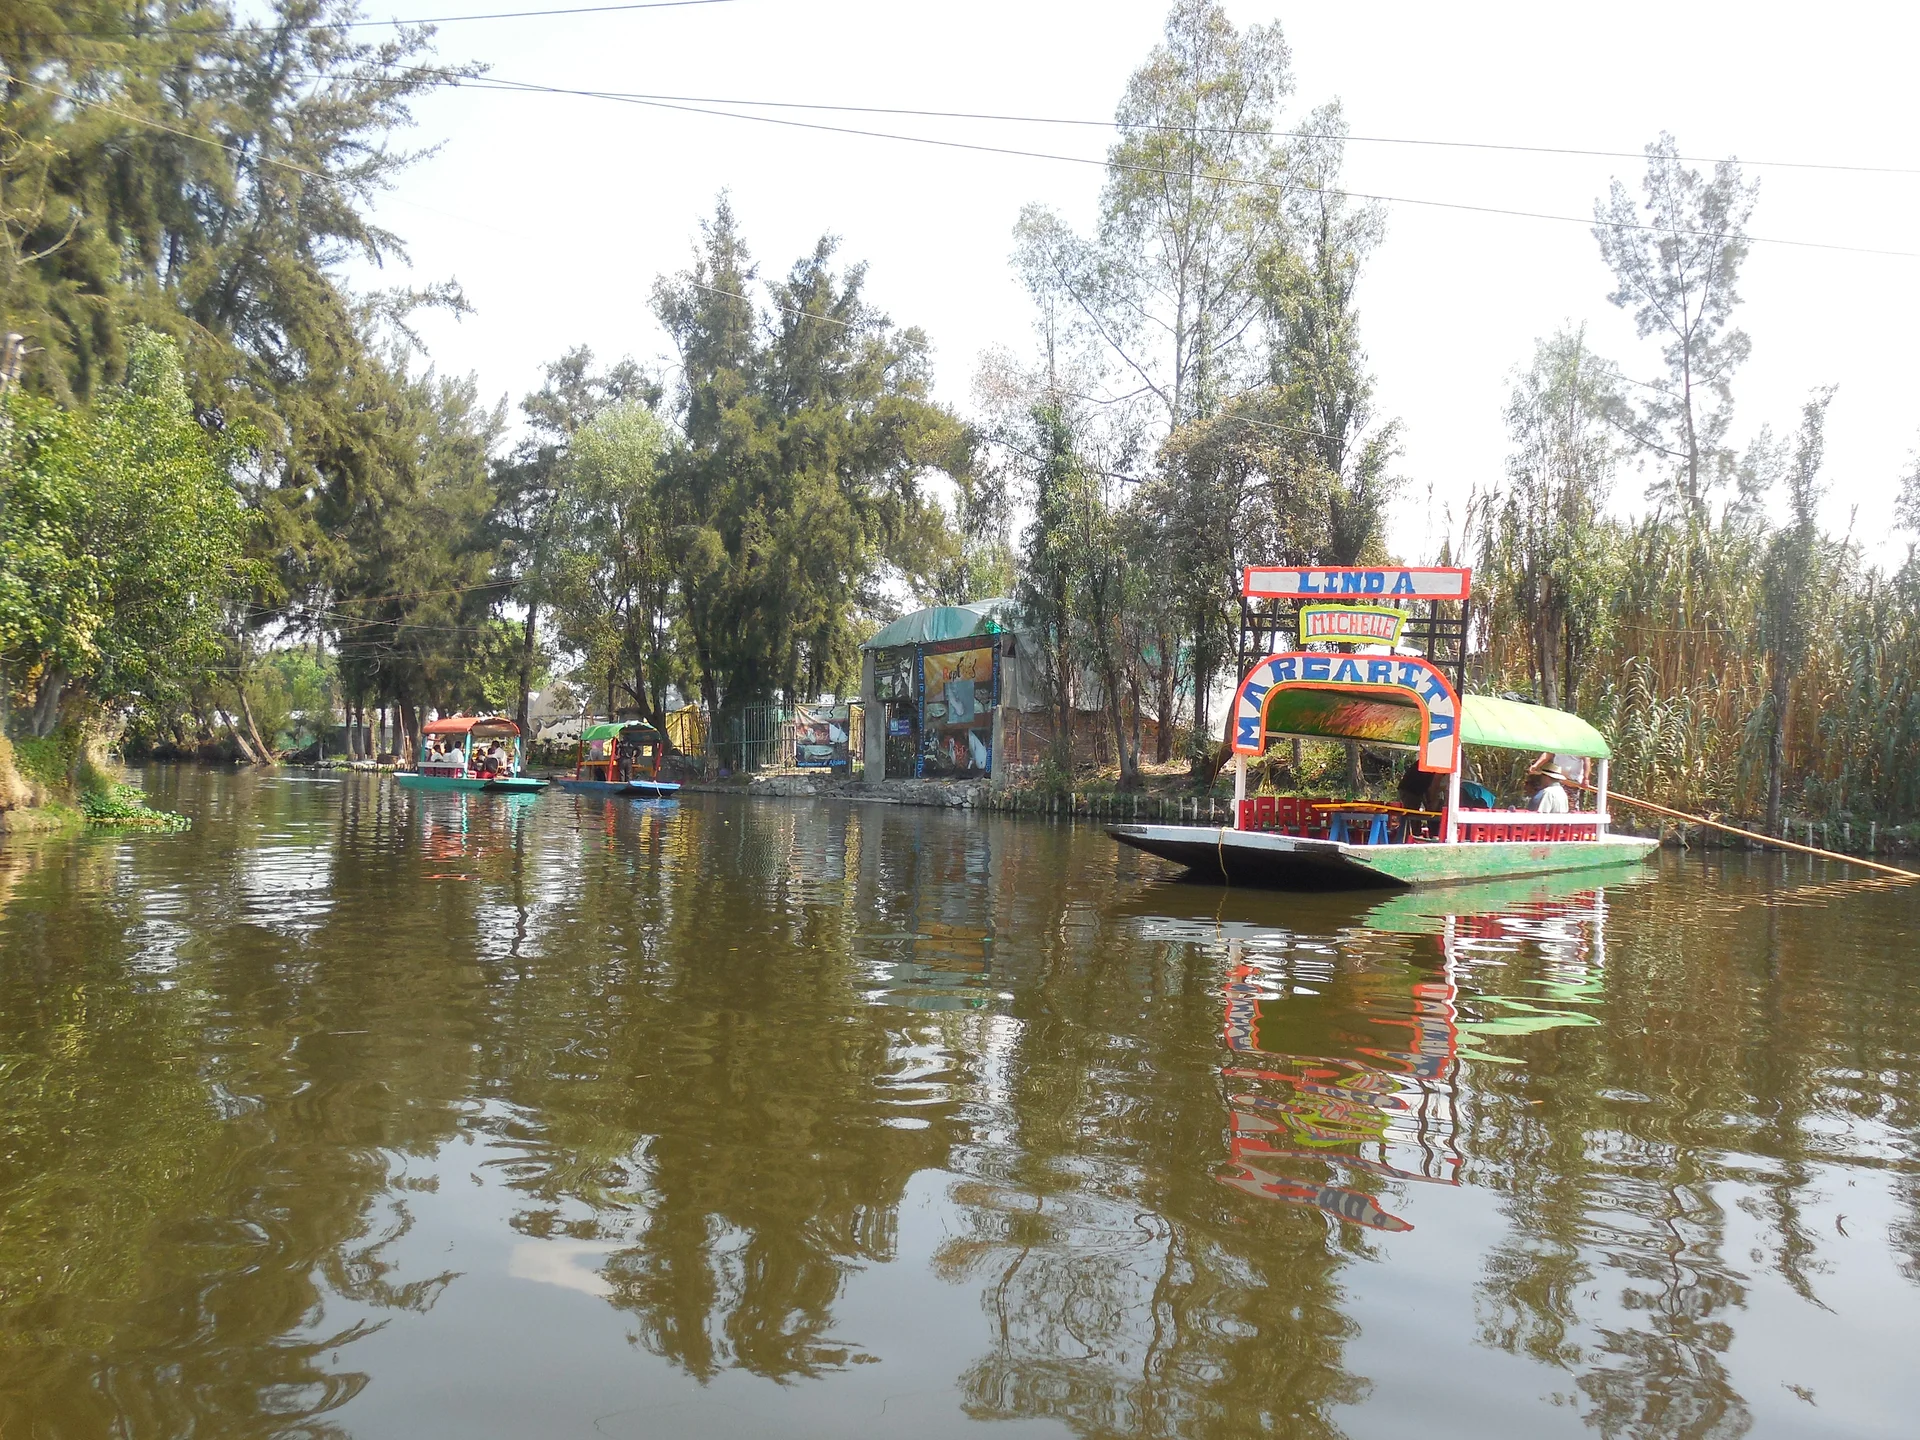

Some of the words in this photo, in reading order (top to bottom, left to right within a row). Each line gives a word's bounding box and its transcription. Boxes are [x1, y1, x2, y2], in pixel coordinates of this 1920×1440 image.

[1297, 571, 1415, 594] LINDA
[1312, 613, 1396, 638] MICHELLE
[1237, 657, 1454, 747] MARGARITA
